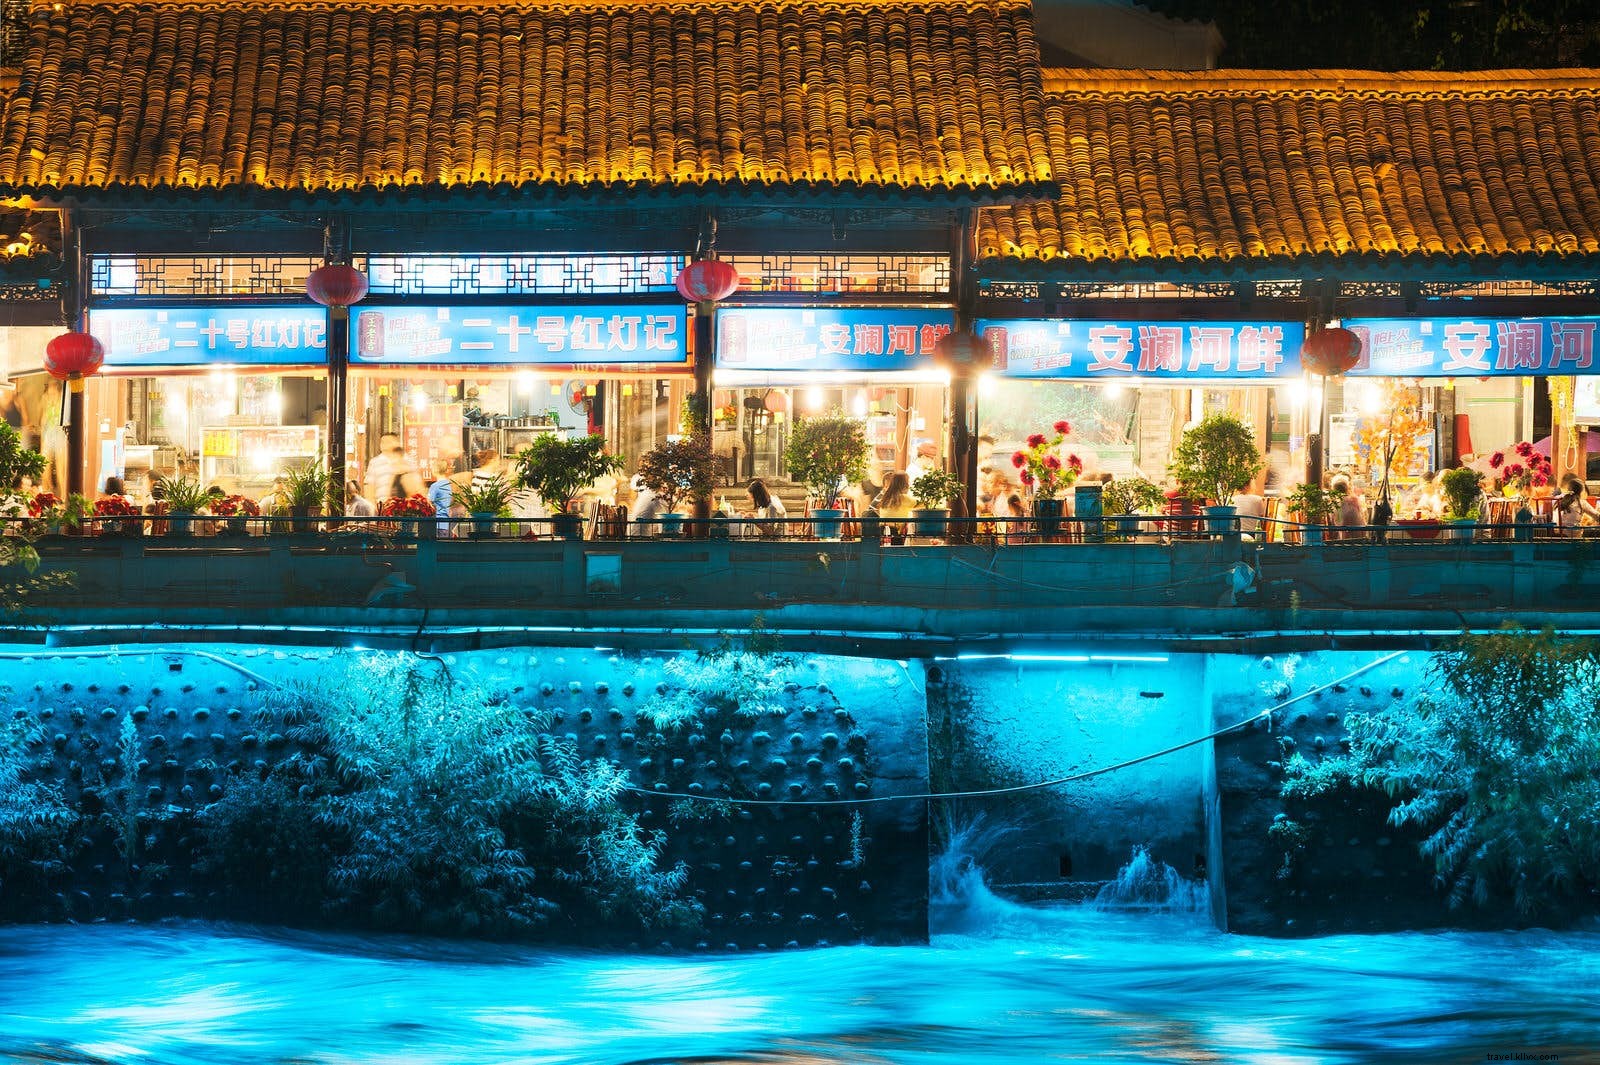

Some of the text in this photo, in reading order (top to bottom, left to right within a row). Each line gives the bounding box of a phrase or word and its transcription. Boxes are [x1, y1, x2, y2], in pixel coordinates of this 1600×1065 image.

[174, 318, 327, 349] 二十号红灯记
[460, 315, 678, 352] 二十号红灯记
[1087, 325, 1284, 373] 安澜河鲜
[1442, 321, 1597, 371] 安澜河
